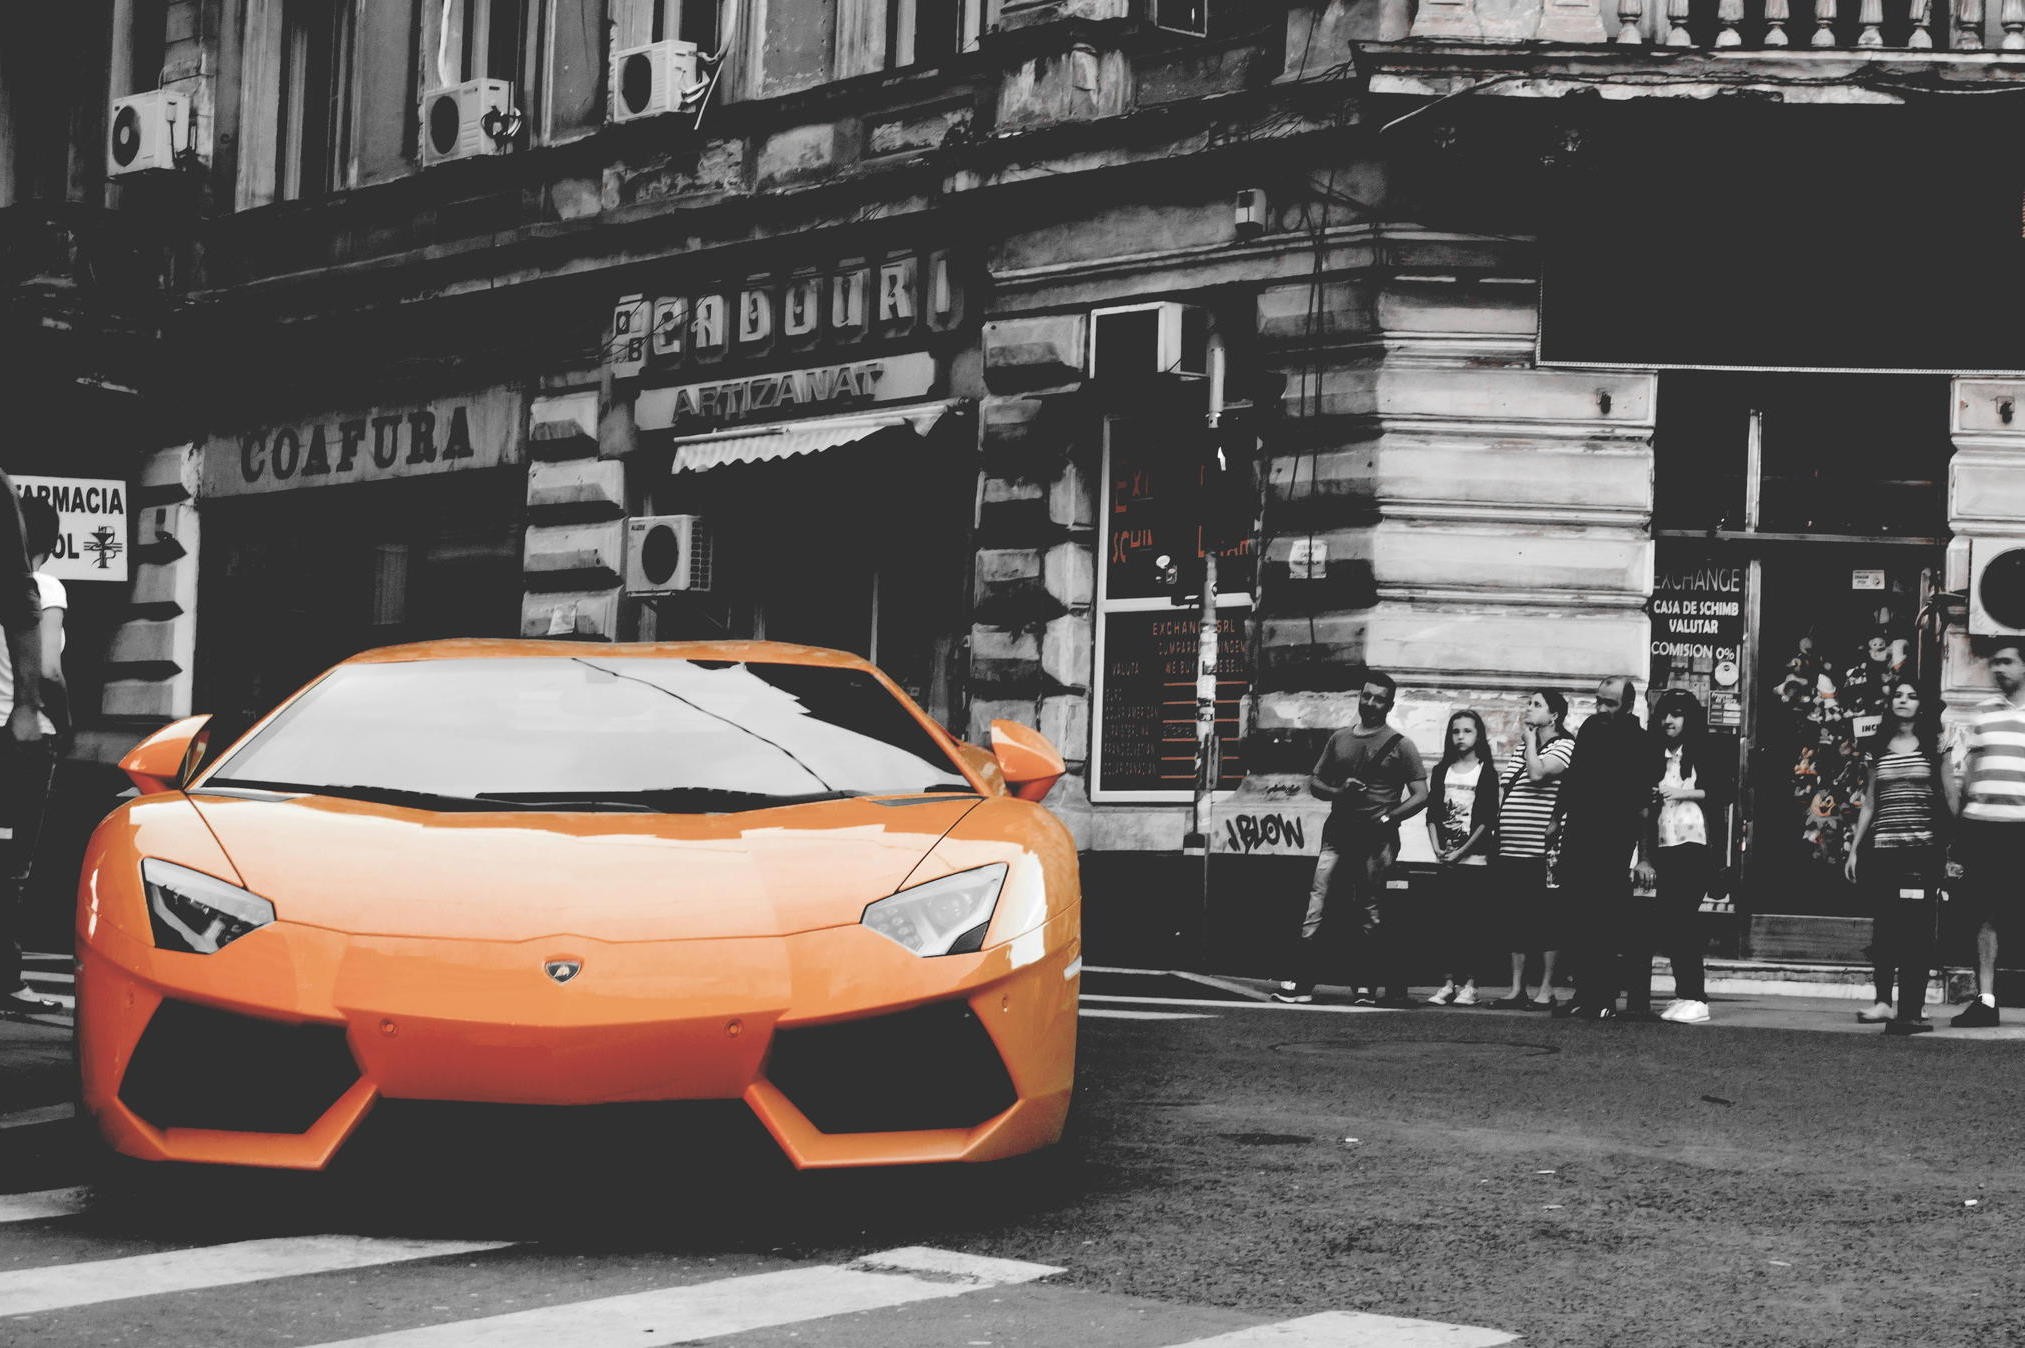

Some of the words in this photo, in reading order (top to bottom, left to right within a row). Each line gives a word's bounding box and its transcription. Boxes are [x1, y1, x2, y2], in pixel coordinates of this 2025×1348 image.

[671, 362, 885, 424] ARTIZANAT
[240, 405, 475, 484] COAFURA
[1653, 599, 1680, 615] CASA
[1682, 600, 1698, 615] DE
[1699, 600, 1739, 617] SCHIMB
[1152, 620, 1201, 636] EXCHAN
[1668, 618, 1719, 634] VALUTAR
[1651, 640, 1714, 659] COMISION
